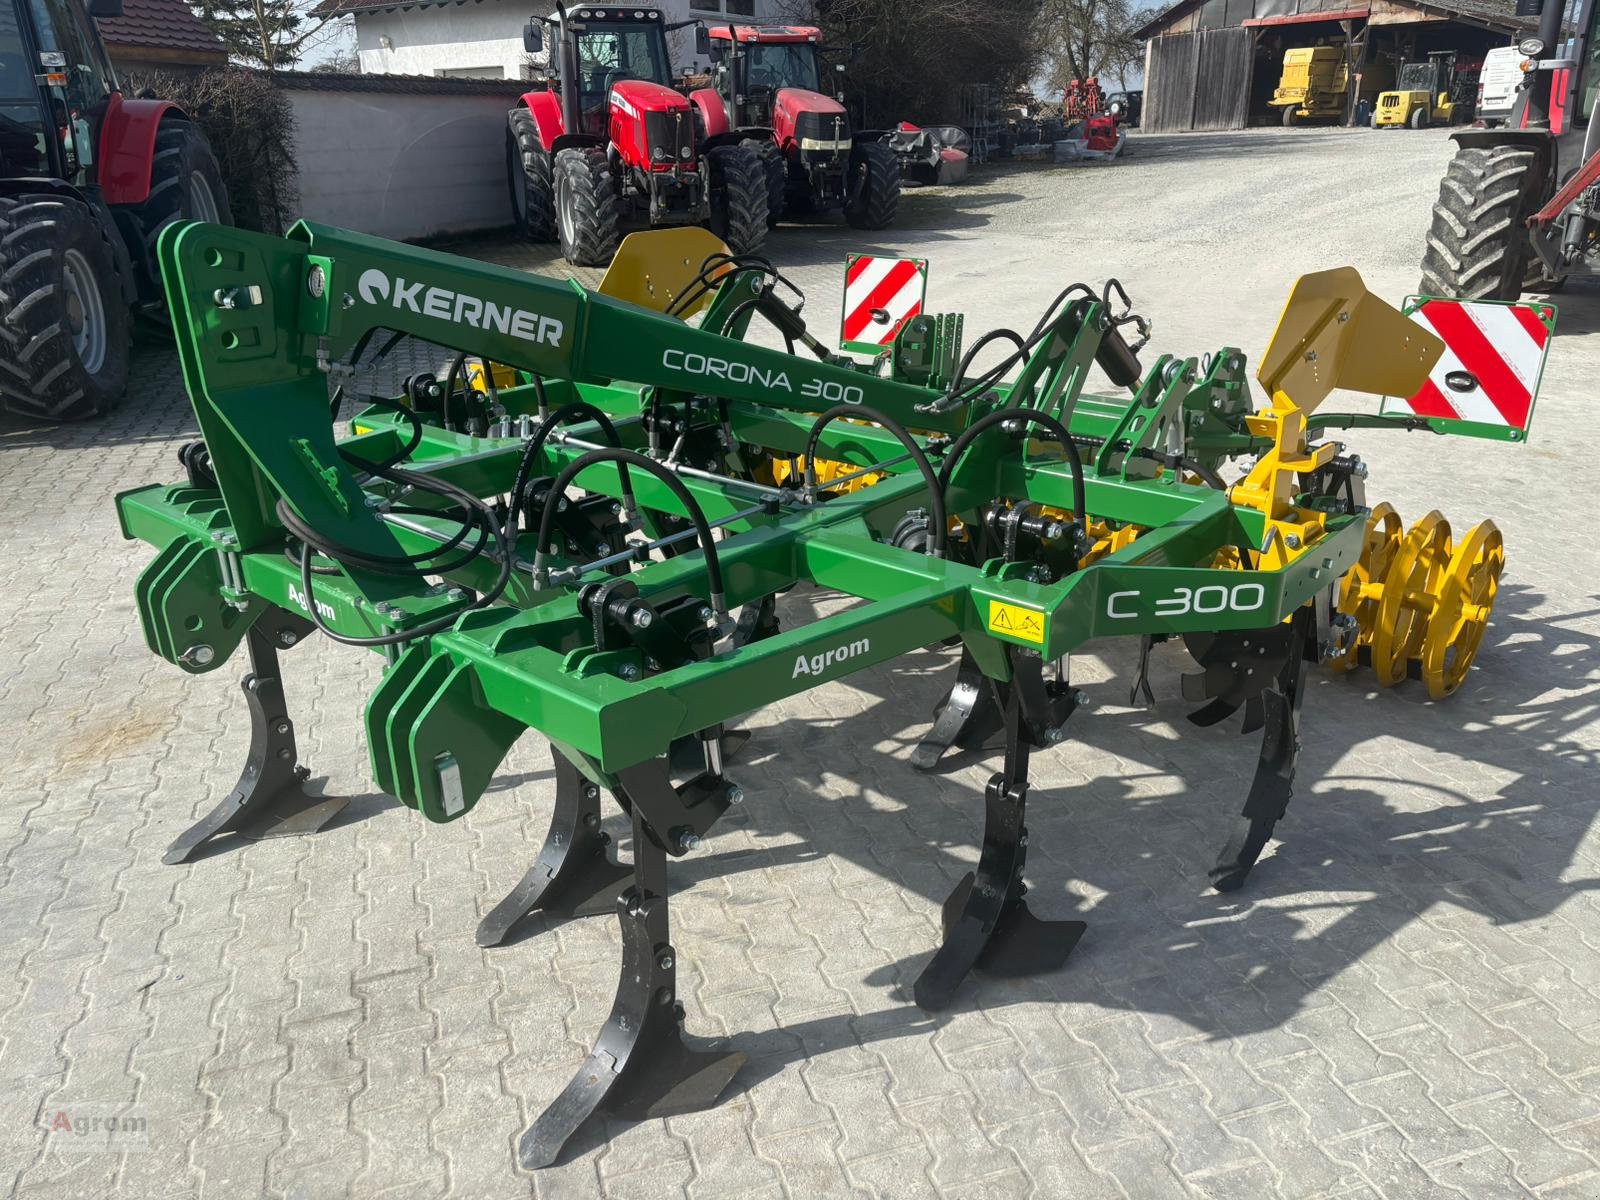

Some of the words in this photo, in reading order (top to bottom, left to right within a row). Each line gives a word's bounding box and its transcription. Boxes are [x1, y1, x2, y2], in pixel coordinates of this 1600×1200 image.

[392, 277, 564, 347] KERNER
[662, 349, 793, 392] CORONA
[800, 378, 864, 405] 300
[289, 583, 336, 621] Agom
[1107, 590, 1141, 618] C
[1154, 583, 1265, 616] 300
[791, 638, 870, 679] Agrom
